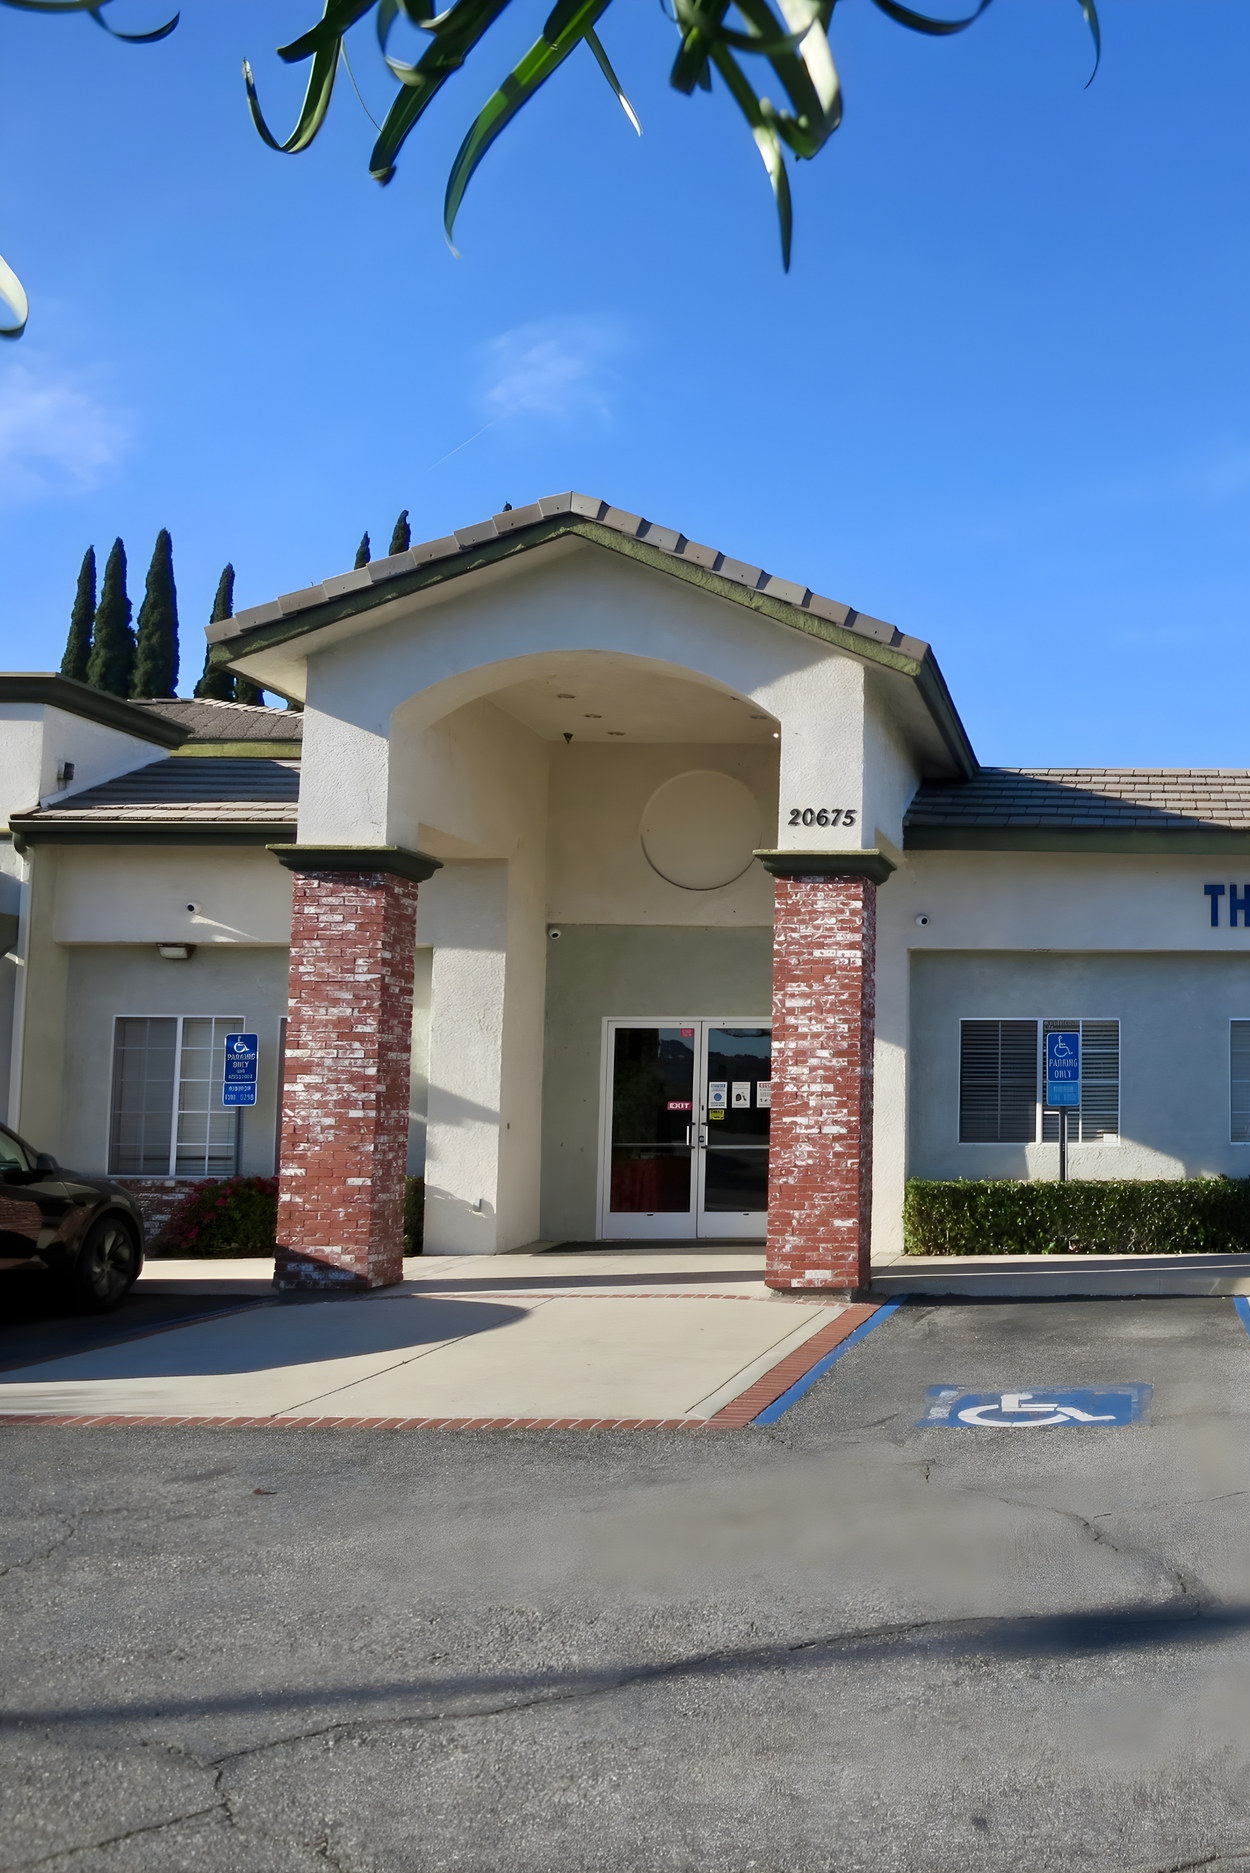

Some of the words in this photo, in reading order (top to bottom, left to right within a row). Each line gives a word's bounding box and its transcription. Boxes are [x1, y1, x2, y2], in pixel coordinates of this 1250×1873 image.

[788, 808, 858, 828] 20675
[1049, 1059, 1078, 1067] PARKING
[1054, 1070, 1072, 1078] ONLY
